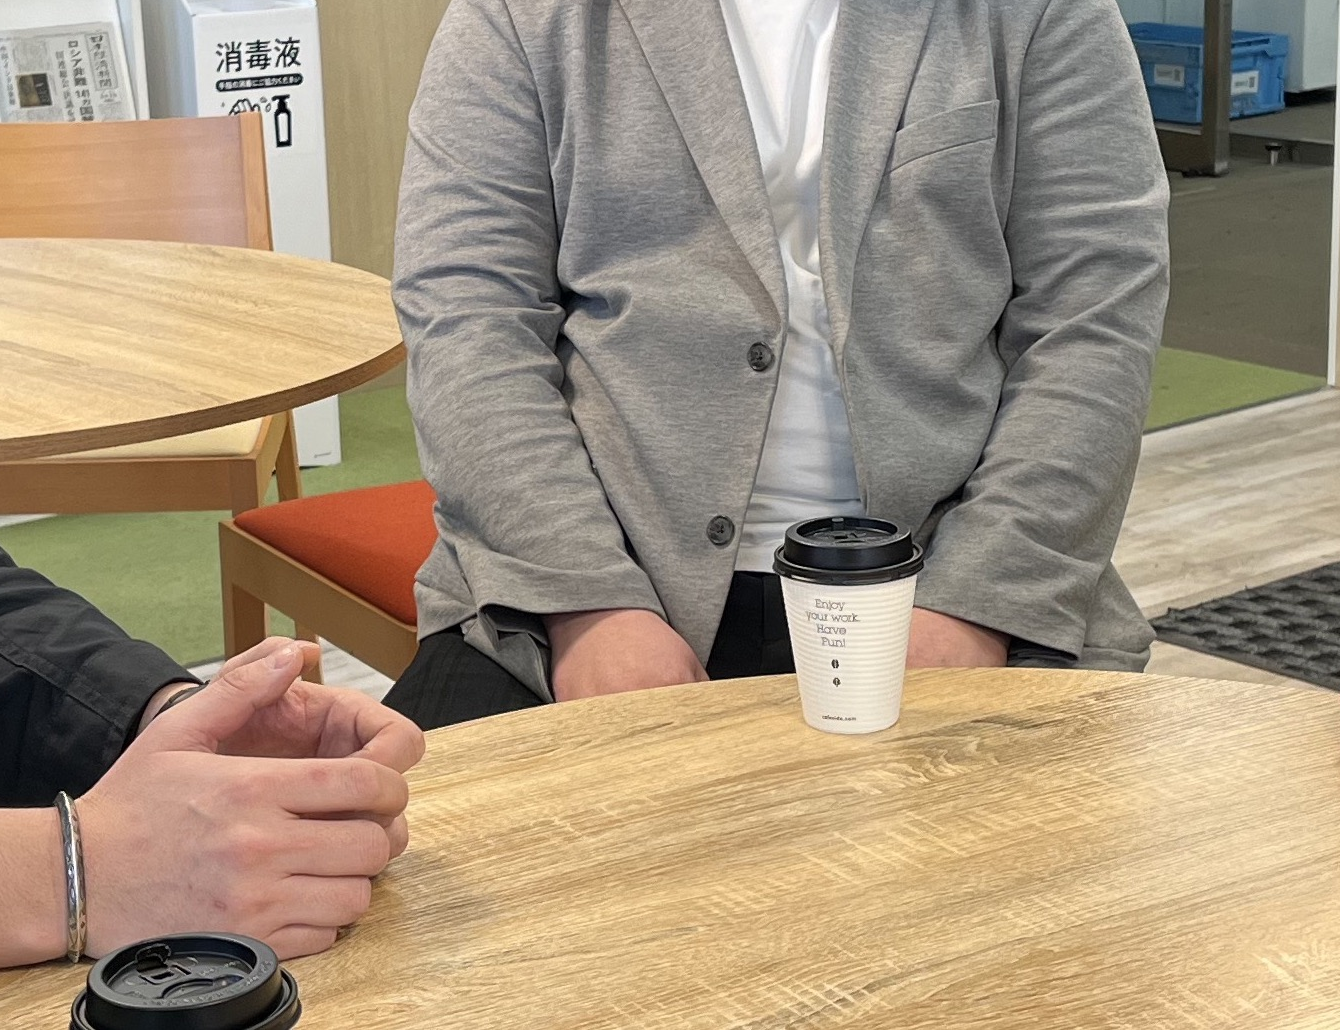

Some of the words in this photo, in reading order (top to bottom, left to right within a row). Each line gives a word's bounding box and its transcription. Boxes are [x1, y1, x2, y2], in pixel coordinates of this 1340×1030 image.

[215, 36, 302, 74] 消毒液
[814, 598, 846, 611] Enjoy
[805, 610, 828, 621] your
[816, 623, 847, 635] Have
[821, 636, 846, 648] Fun!
